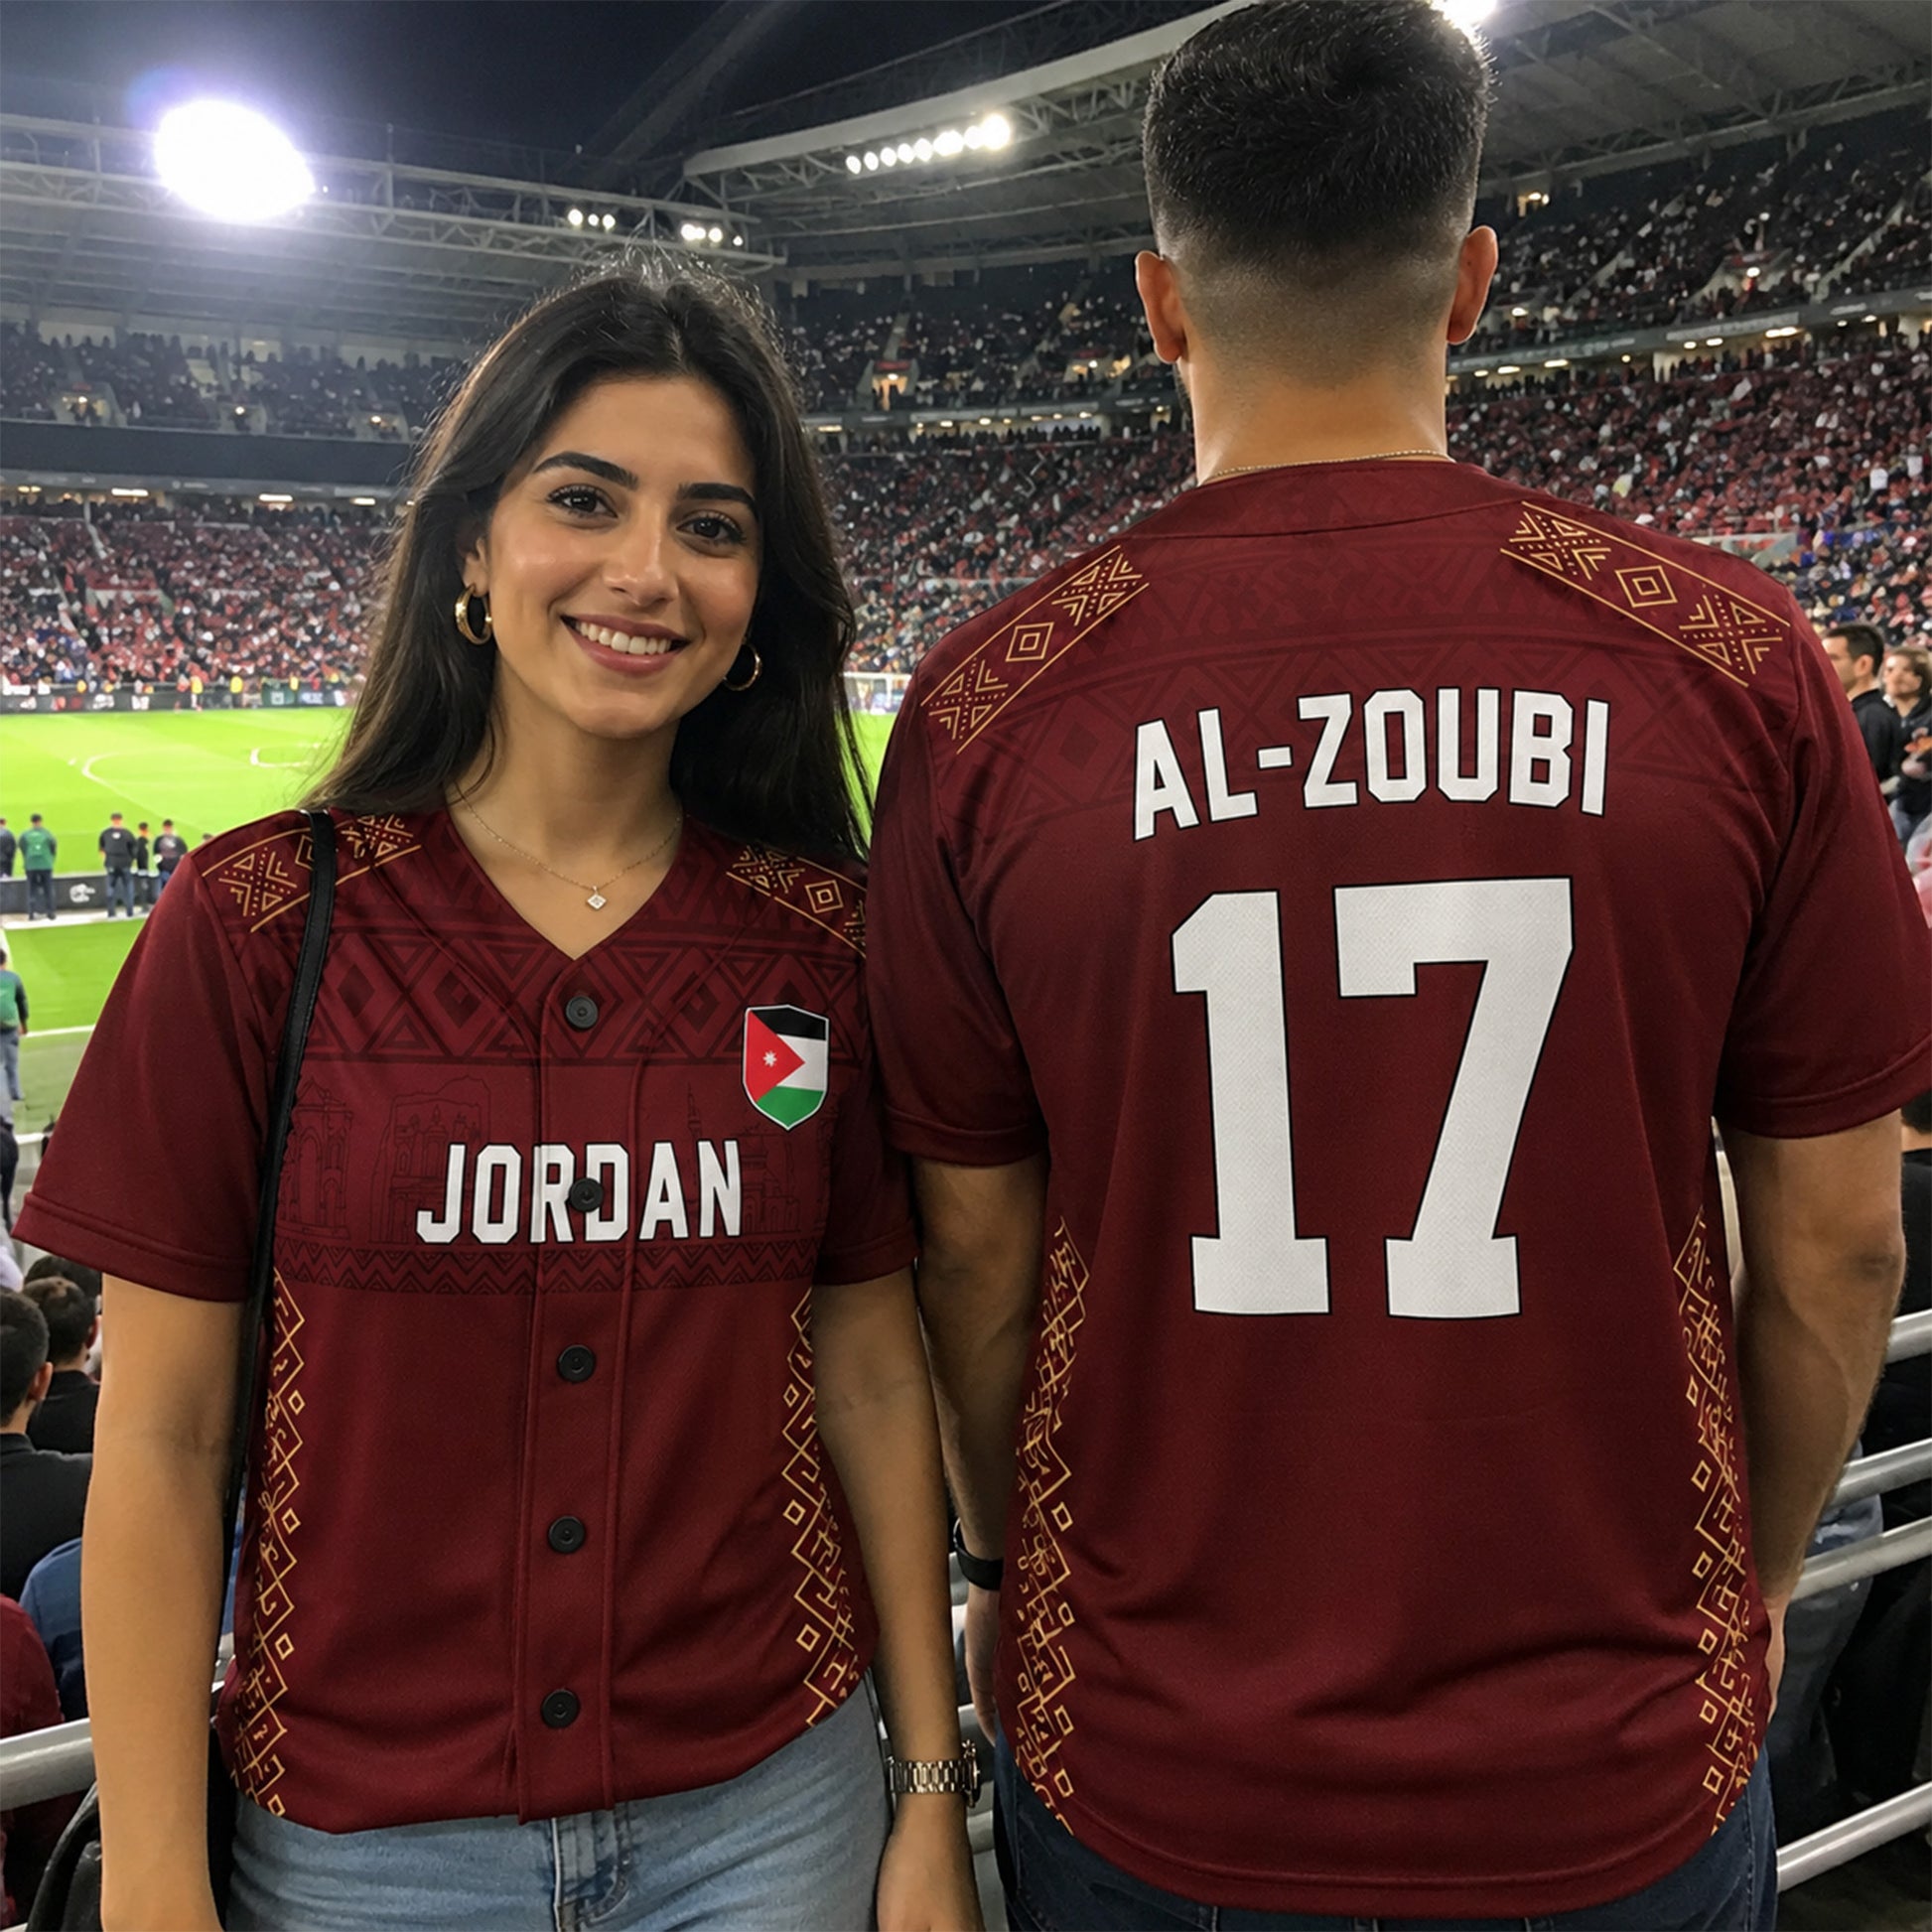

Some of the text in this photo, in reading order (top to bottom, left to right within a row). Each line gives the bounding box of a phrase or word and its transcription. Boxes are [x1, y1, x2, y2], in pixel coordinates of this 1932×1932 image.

[1134, 687, 1609, 841] AL-ZOUBI
[1172, 877, 1574, 1318] 17
[417, 1140, 742, 1245] JORDAN
